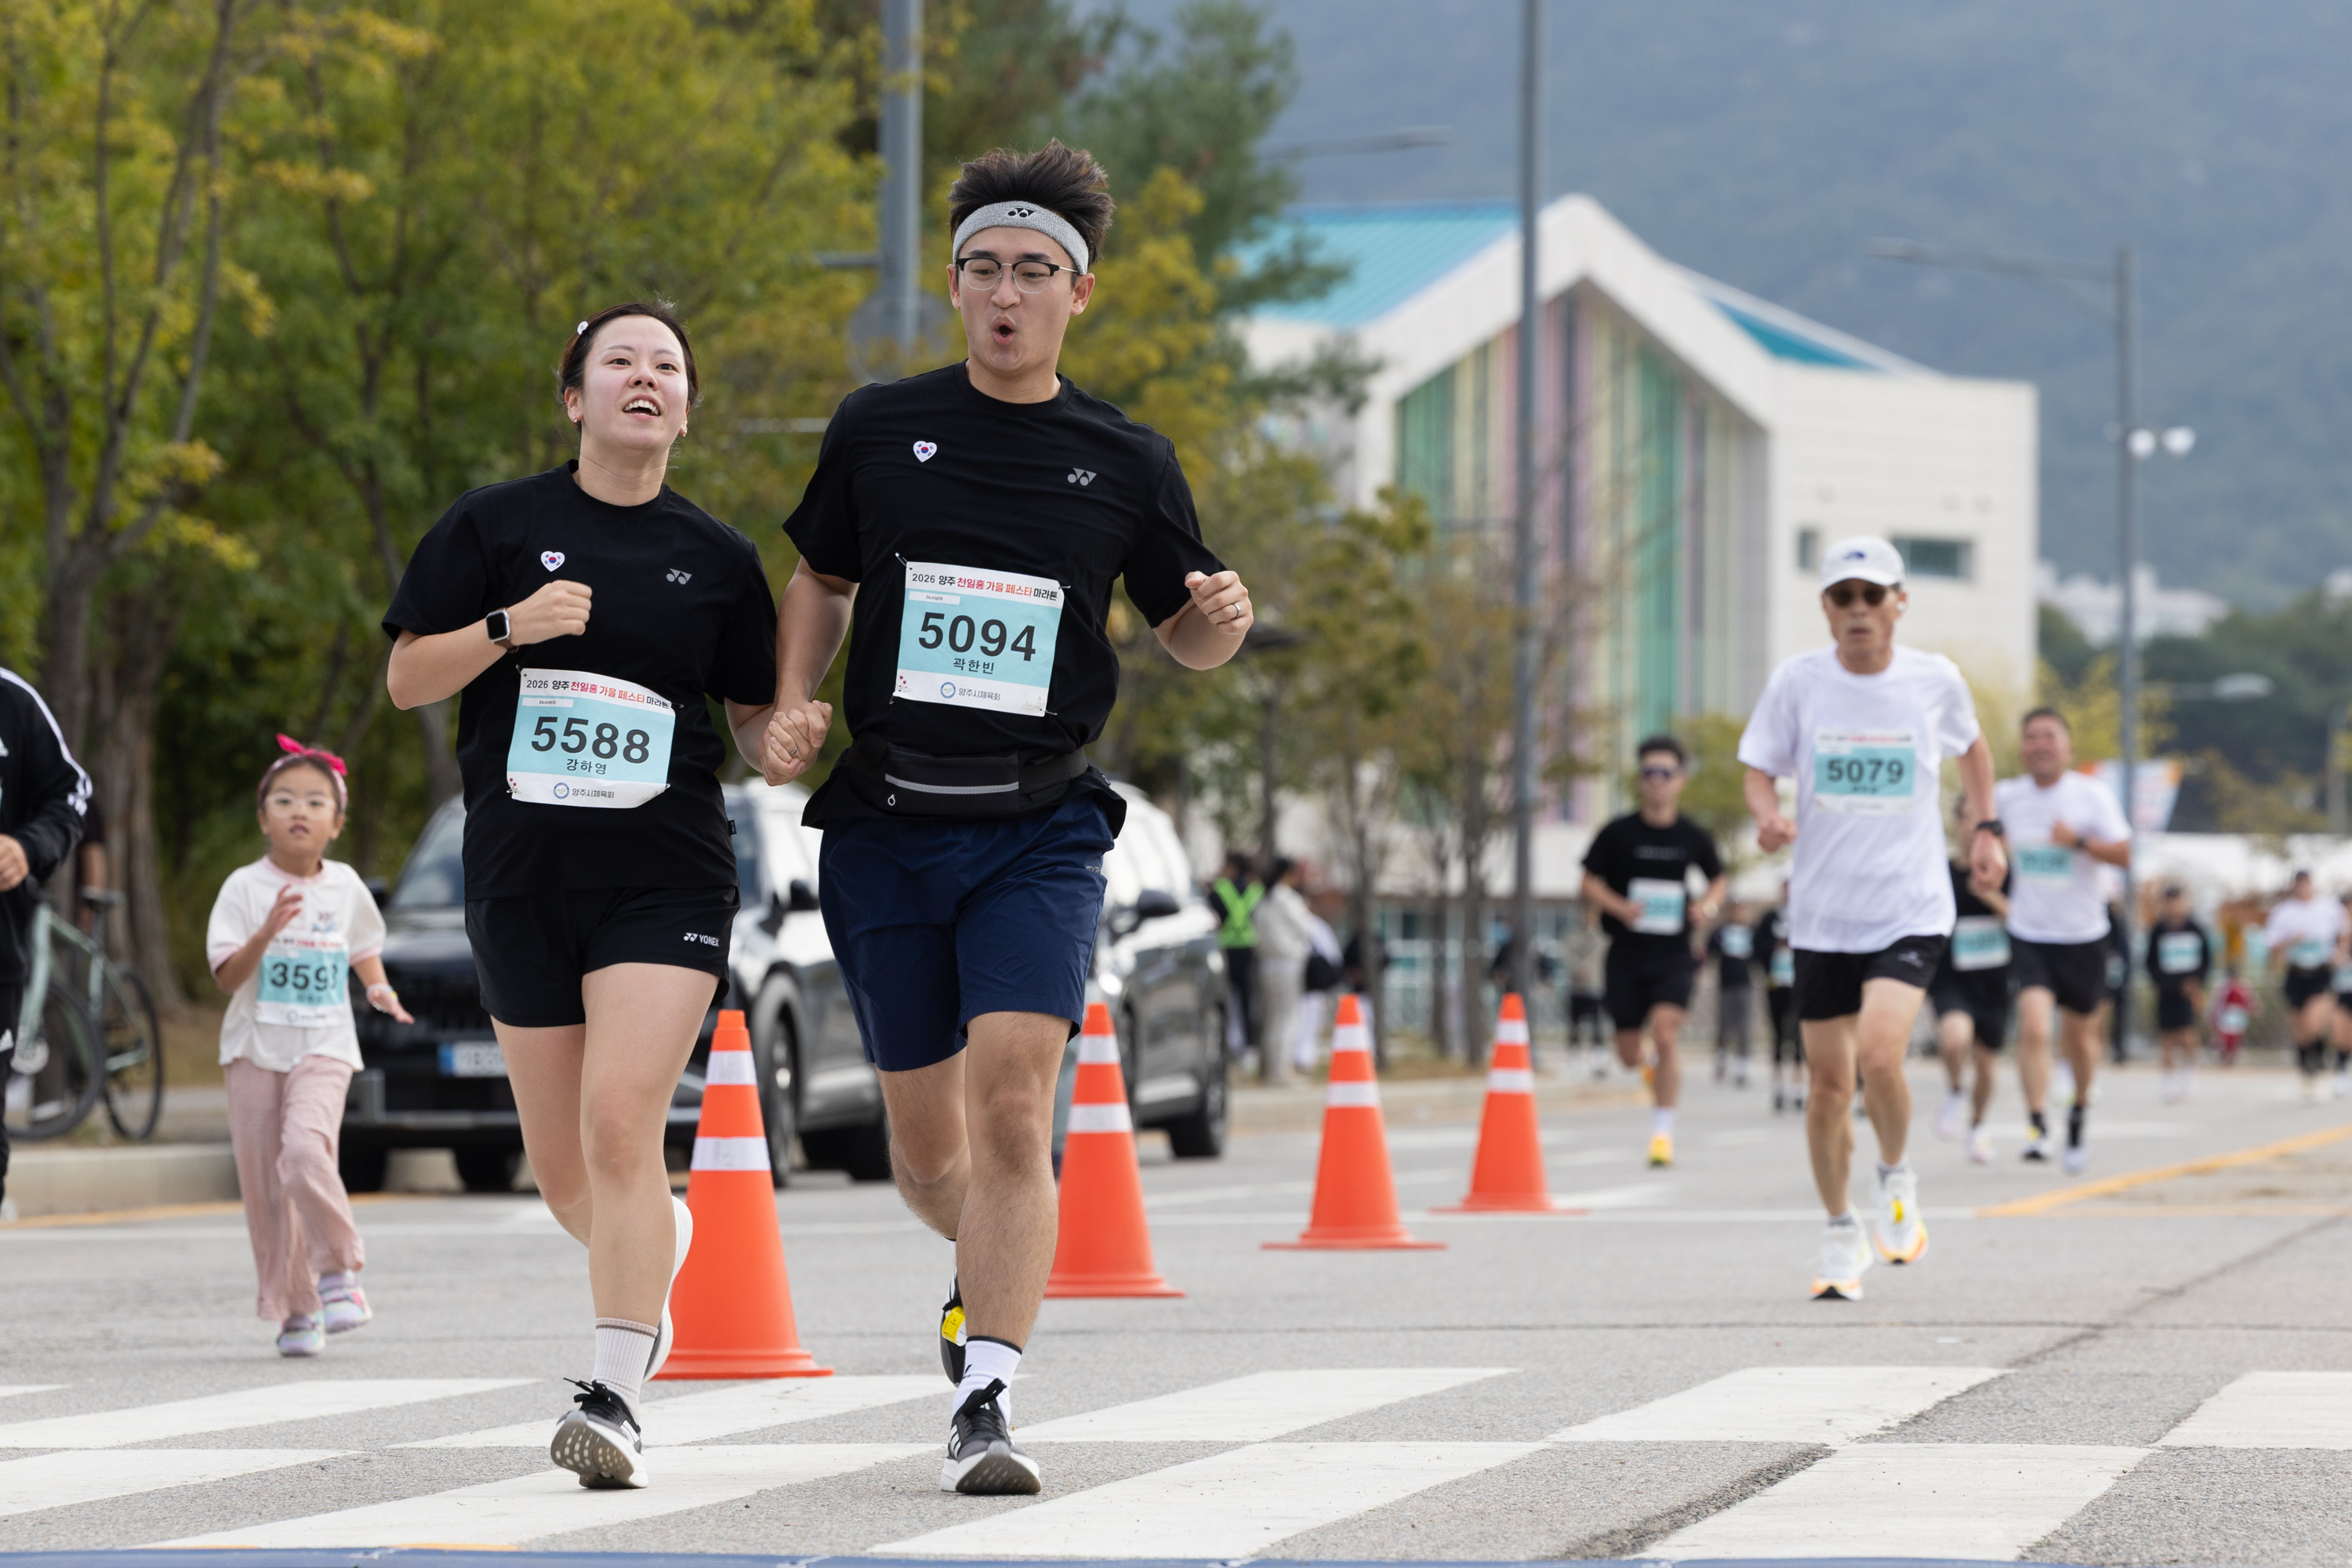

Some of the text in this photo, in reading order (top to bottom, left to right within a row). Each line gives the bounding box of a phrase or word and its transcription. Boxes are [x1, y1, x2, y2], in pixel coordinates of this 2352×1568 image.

[912, 573, 1058, 601] 2026 양주 천일홍 가을 페스타 마라톤
[918, 612, 1036, 662] 5094
[953, 658, 994, 674] 곽한빈
[526, 680, 549, 688] 2026
[552, 681, 570, 691] 양주
[571, 681, 598, 694] 천일홍
[599, 686, 616, 698] 가을
[618, 690, 645, 703] 페스타
[959, 688, 1001, 701] 양주시체육회
[531, 716, 650, 764] 5588
[566, 758, 607, 775] 강하영
[1827, 758, 1904, 785] 5079
[572, 788, 615, 798] 양주시체육회
[699, 934, 720, 947] YONEX
